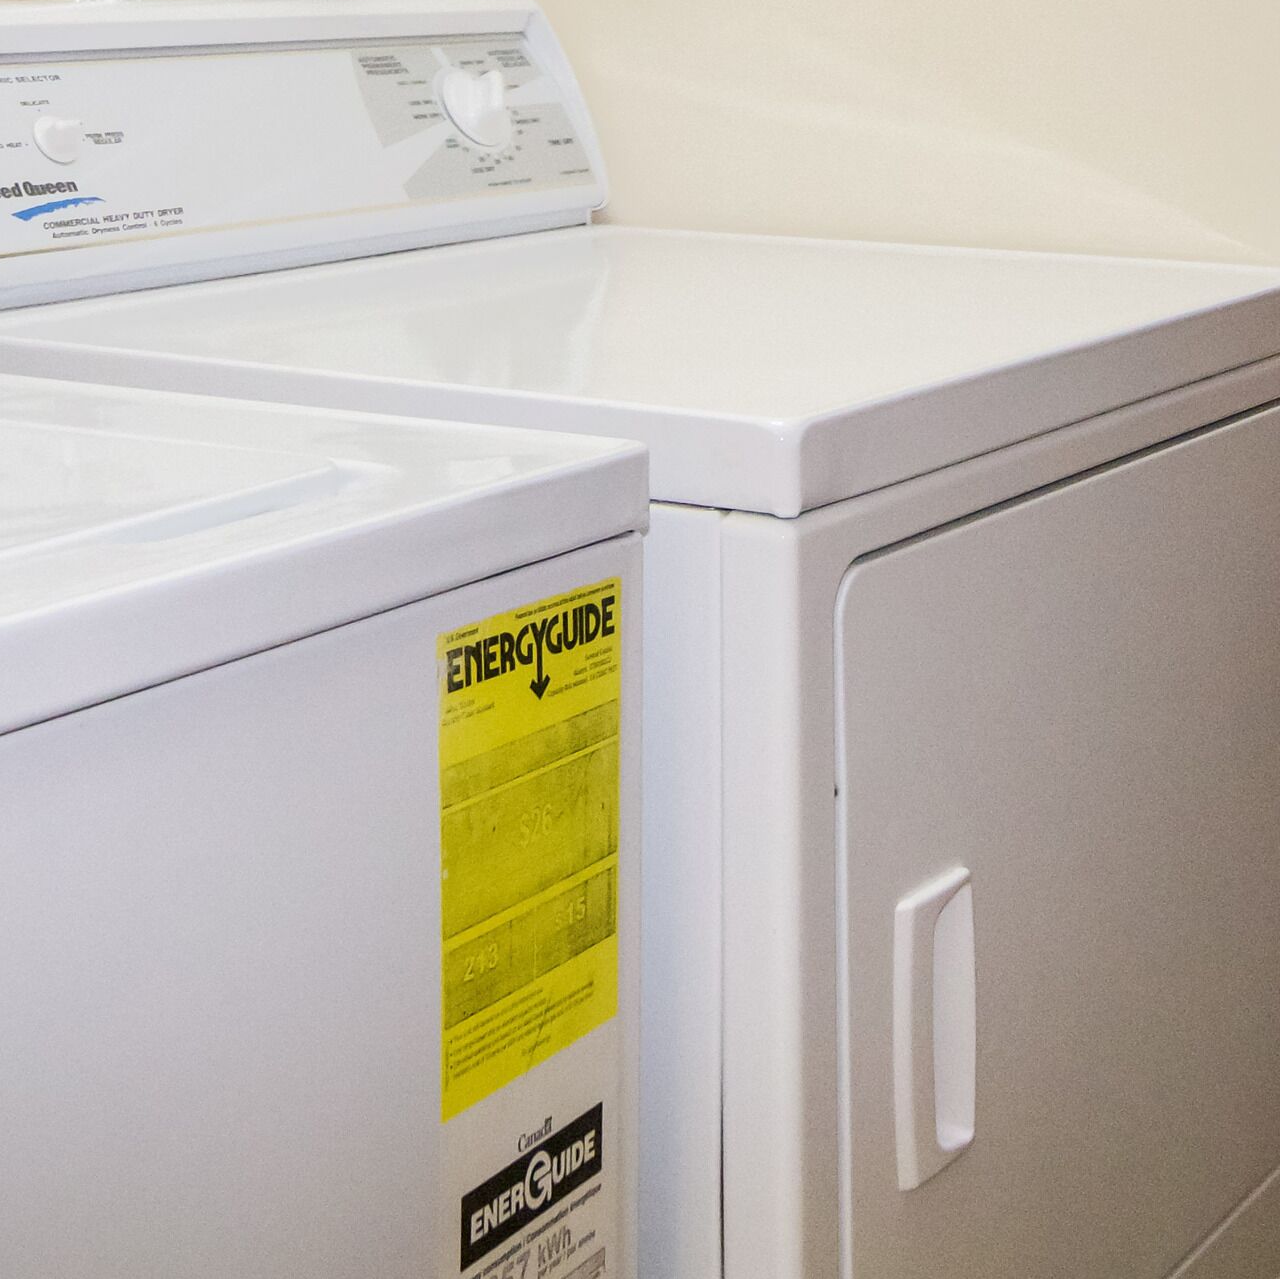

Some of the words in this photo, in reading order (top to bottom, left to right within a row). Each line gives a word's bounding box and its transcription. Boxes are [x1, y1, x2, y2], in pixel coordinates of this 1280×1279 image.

[15, 74, 61, 83] SELECTOR
[22, 180, 79, 196] Queen
[42, 217, 100, 230] COMMERCIAL
[102, 213, 130, 224] HEAVY
[132, 210, 155, 221] DUTY
[157, 206, 185, 217] DRYER
[445, 594, 617, 694] ENERGYGUIDE
[470, 1128, 597, 1247] ENERGUIDE
